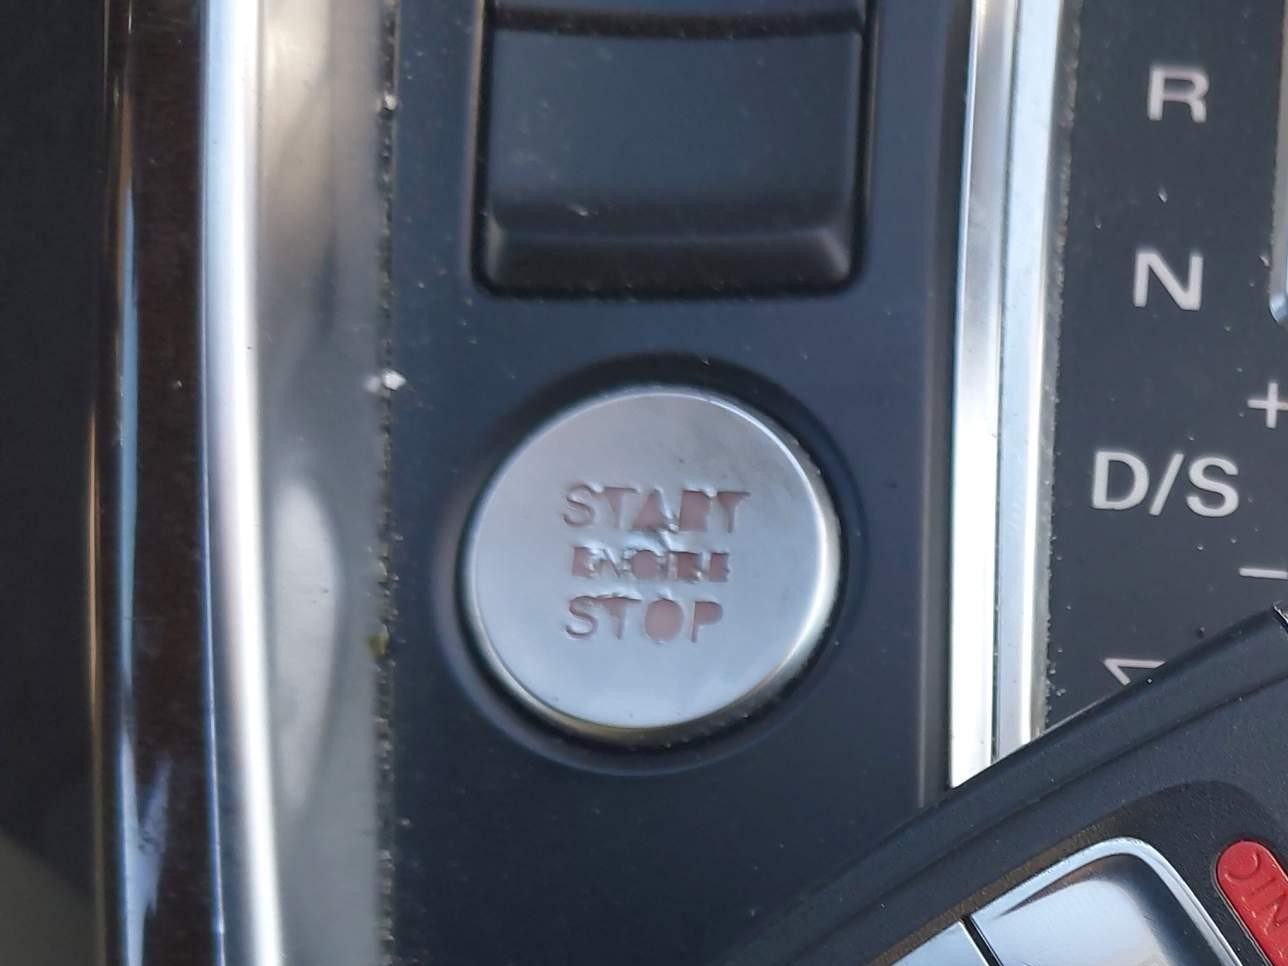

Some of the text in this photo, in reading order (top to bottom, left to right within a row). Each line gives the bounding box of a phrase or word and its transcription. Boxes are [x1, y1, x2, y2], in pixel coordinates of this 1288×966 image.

[1147, 65, 1210, 123] R
[1132, 249, 1204, 312] N
[562, 482, 752, 533] START
[1091, 449, 1240, 518] D/S
[565, 594, 724, 643] STOP
